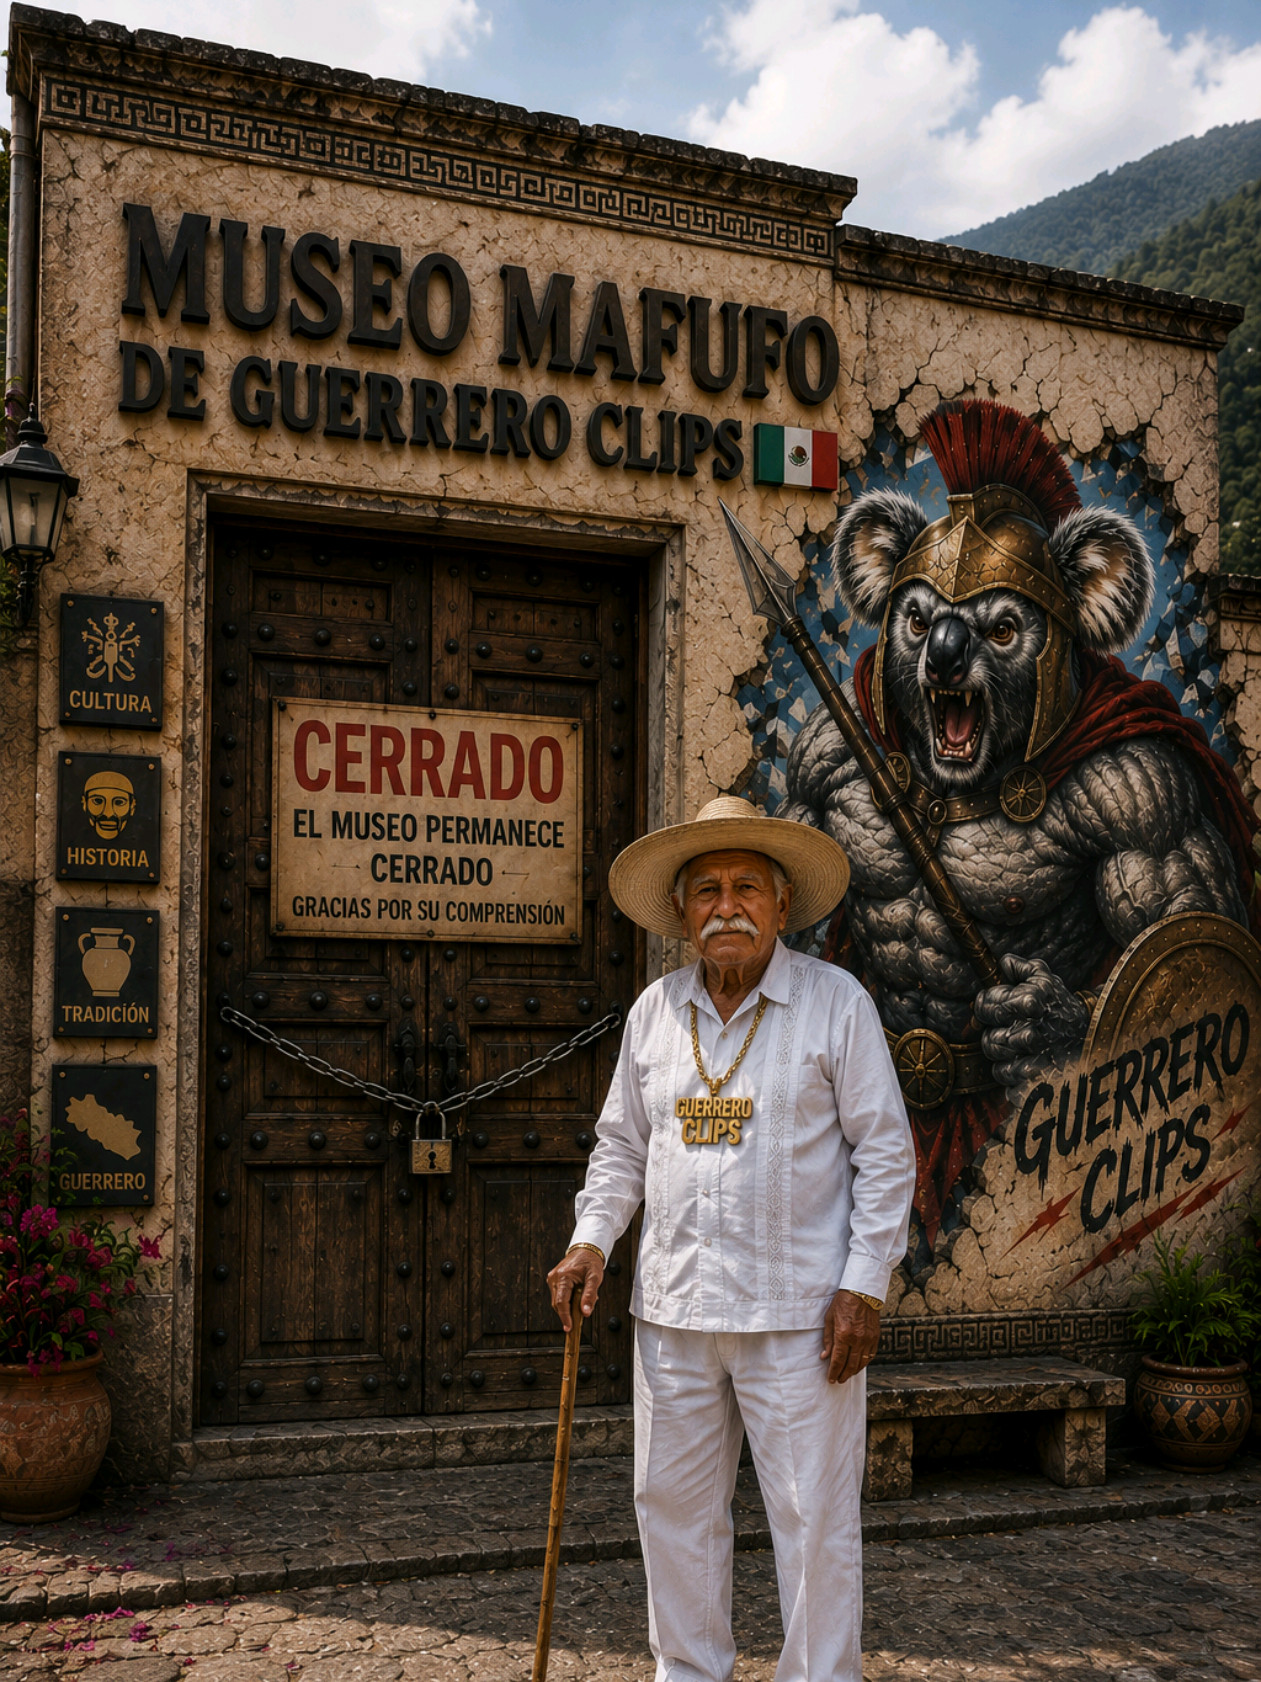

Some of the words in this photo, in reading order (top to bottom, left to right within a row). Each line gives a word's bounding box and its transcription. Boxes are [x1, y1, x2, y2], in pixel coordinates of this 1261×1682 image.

[122, 203, 470, 357] MUSEO
[499, 265, 840, 405] MAFUFO
[118, 341, 205, 421] DE
[230, 355, 572, 461] GUERRERO
[587, 401, 743, 480] CLIPS
[69, 690, 152, 713] CULTURA
[293, 719, 564, 804] CERRADO
[293, 809, 322, 839] EL
[331, 811, 417, 842] MUSEO
[426, 815, 564, 848] PERMANECE
[67, 847, 149, 868] HISTORIA
[371, 853, 493, 886] CERRADO
[292, 896, 371, 919] GRACIAS
[378, 899, 412, 921] POR
[418, 900, 440, 921] SU
[446, 900, 565, 925] COMPRENSIÓN
[675, 1097, 753, 1119] GUERRERO
[1014, 1001, 1250, 1200] GUERRERO
[682, 1118, 743, 1145] CLIPS
[59, 1173, 146, 1190] GUERRERO
[1080, 1103, 1211, 1233] CLIPS
